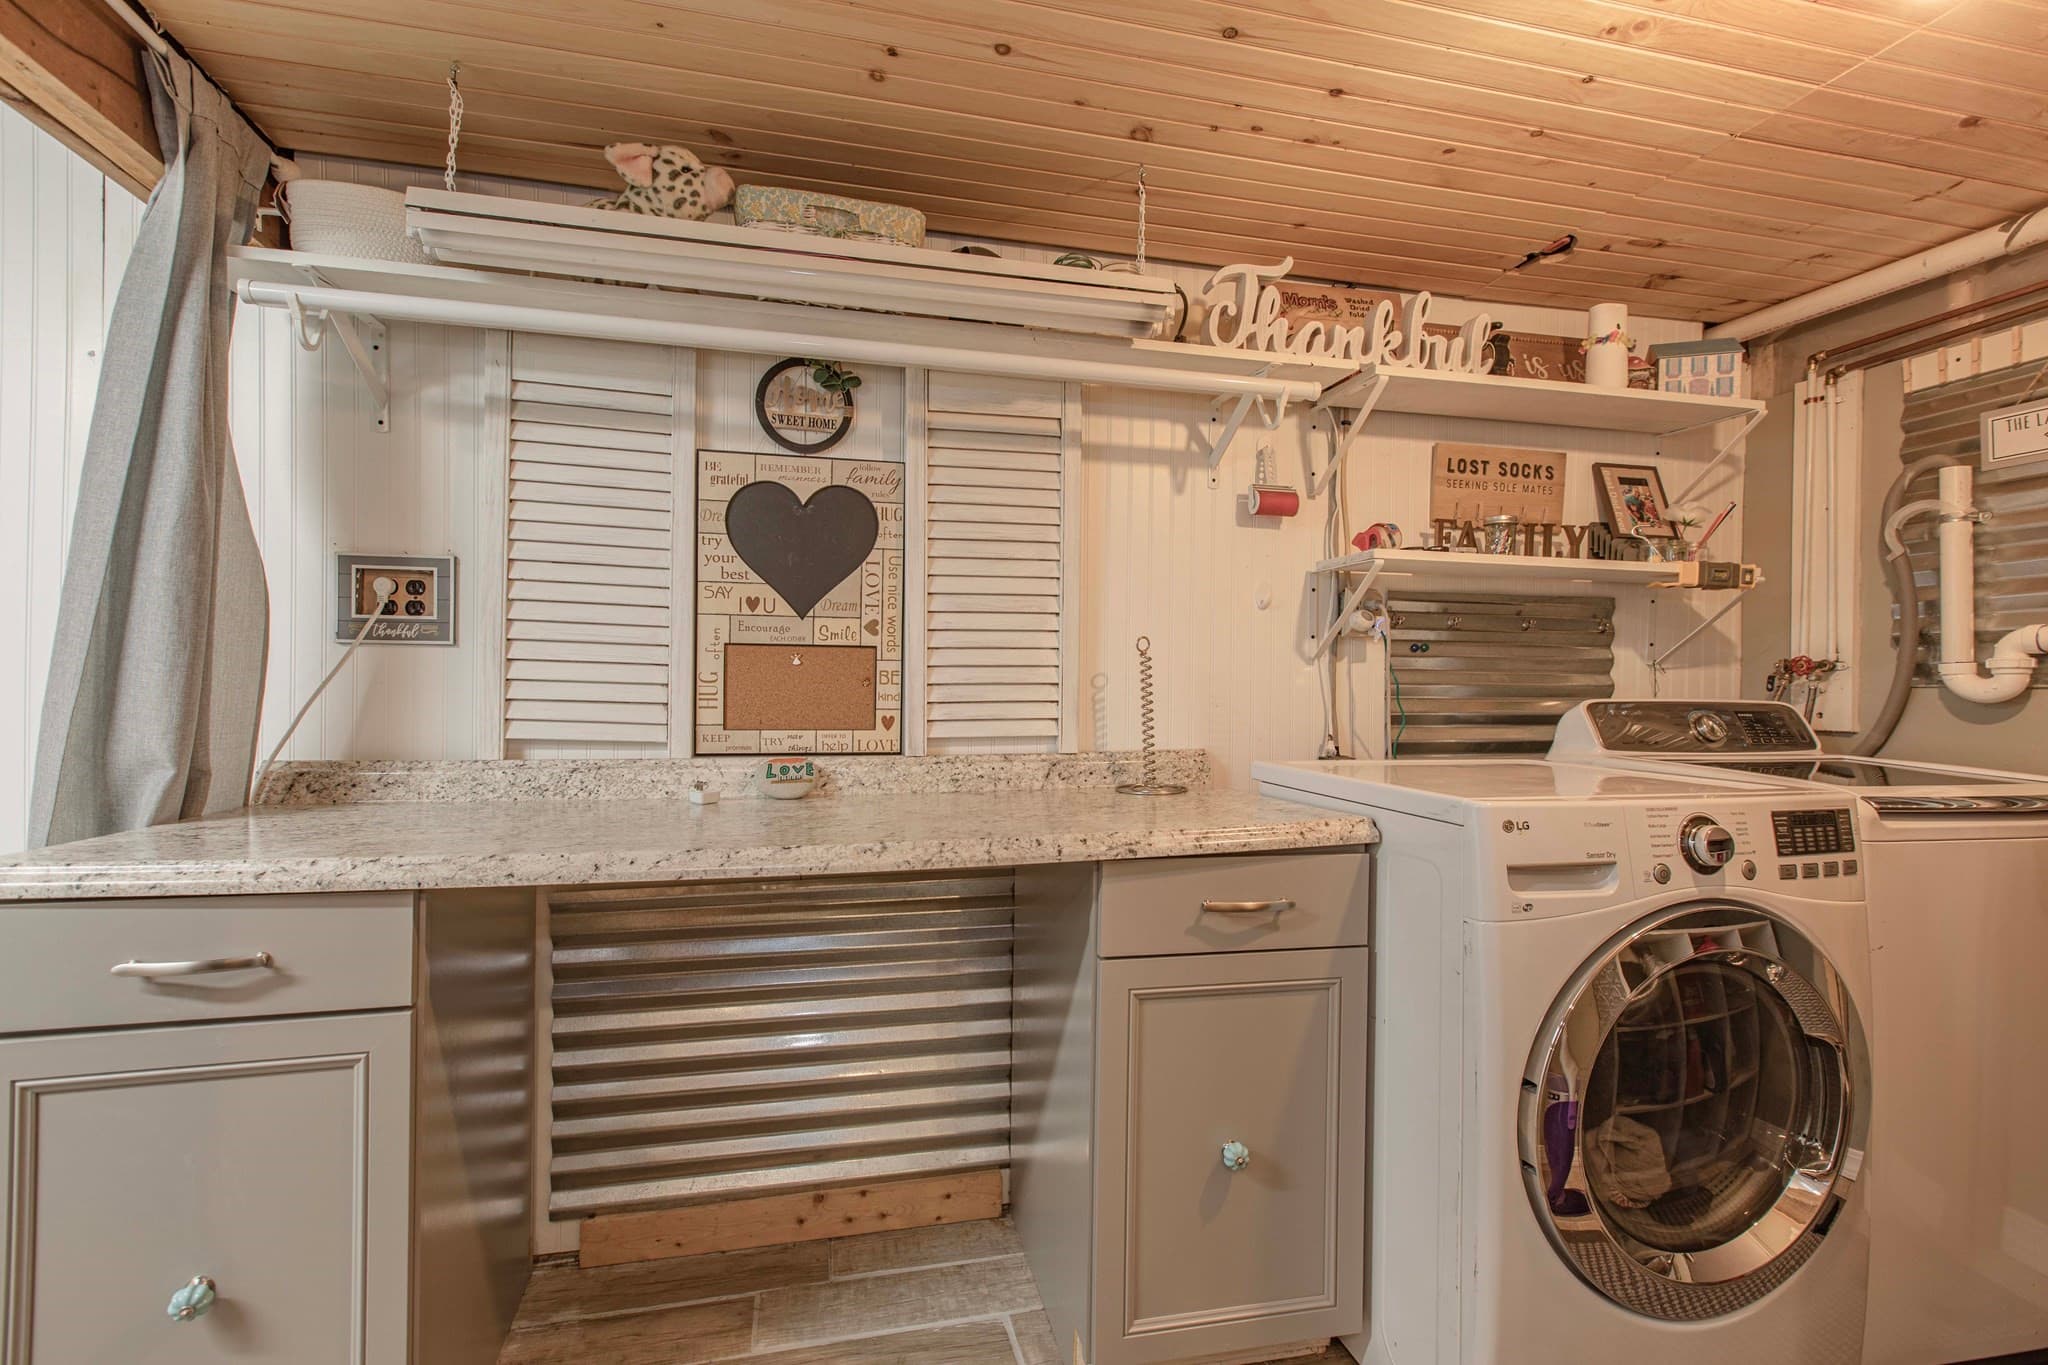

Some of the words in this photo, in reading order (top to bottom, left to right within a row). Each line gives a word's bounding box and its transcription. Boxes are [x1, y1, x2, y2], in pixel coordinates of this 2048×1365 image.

[1281, 292, 1338, 310] Mom's
[1202, 256, 1495, 375] Thankful
[1523, 353, 1549, 379] is
[771, 413, 805, 428] SWEET
[808, 416, 837, 430] HOME
[2005, 415, 2030, 432] THE
[704, 461, 722, 472] BE
[760, 463, 821, 475] REMEMBER
[1447, 457, 1490, 476] LOST
[1498, 461, 1555, 481] SOCKS
[710, 473, 749, 488] grateful
[845, 466, 902, 495] family
[1446, 478, 1489, 491] SEEKING
[1493, 482, 1518, 493] SOLE
[1522, 485, 1554, 495] MATES
[701, 535, 722, 550] try
[1433, 518, 1590, 559] FAILY
[703, 553, 738, 567] your
[887, 555, 903, 580] Use
[720, 565, 750, 580] best
[704, 585, 733, 599] SAY
[865, 561, 881, 617] LOVE
[887, 584, 898, 610] nice
[820, 599, 859, 613] Dream
[371, 622, 421, 638] thankful
[738, 620, 791, 635] Encourage
[818, 624, 858, 642] Smile
[885, 616, 901, 654] words
[704, 627, 722, 660] often
[878, 670, 901, 686] BE
[698, 671, 719, 710] HUG
[701, 734, 731, 743] KEEP
[761, 737, 785, 746] TRY
[821, 739, 849, 753] help
[856, 738, 898, 752] LOVE
[765, 761, 815, 779] LOVE
[1516, 821, 1530, 830] LG
